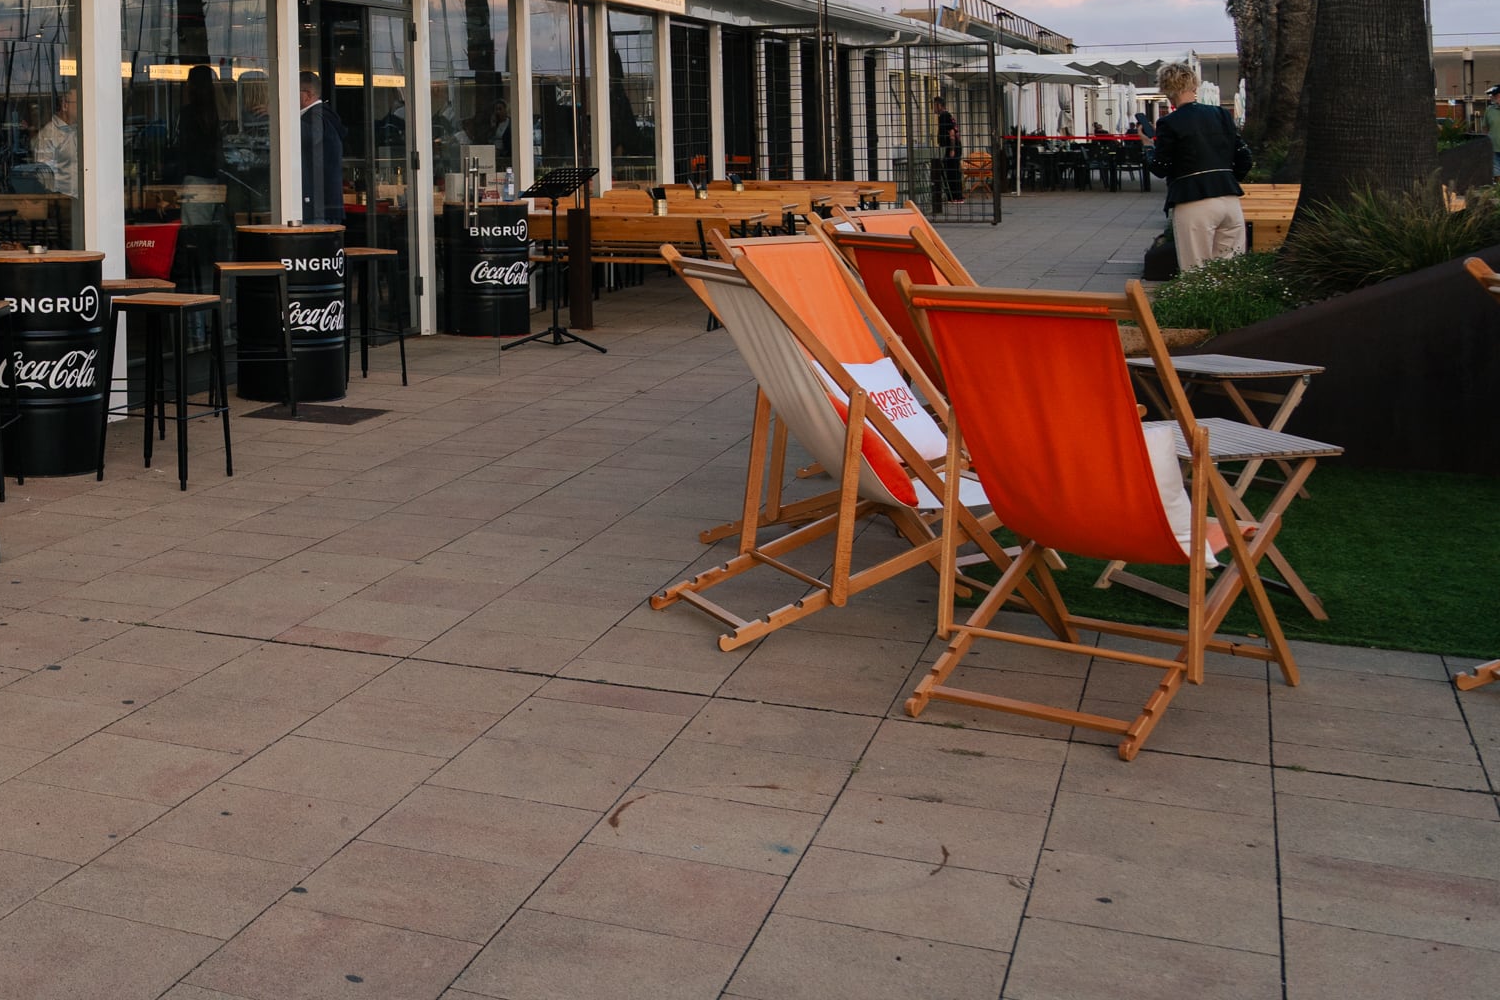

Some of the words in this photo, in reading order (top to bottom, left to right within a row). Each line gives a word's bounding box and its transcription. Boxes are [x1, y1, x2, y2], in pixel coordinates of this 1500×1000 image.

[470, 225, 525, 237] BNGRUP
[126, 240, 155, 248] CAMPARI
[281, 256, 344, 271] BNGRUP
[470, 260, 528, 285] Coca-Cola
[4, 295, 95, 314] BNGRUP
[870, 386, 913, 411] APEROL
[885, 402, 917, 421] SPRITZ
